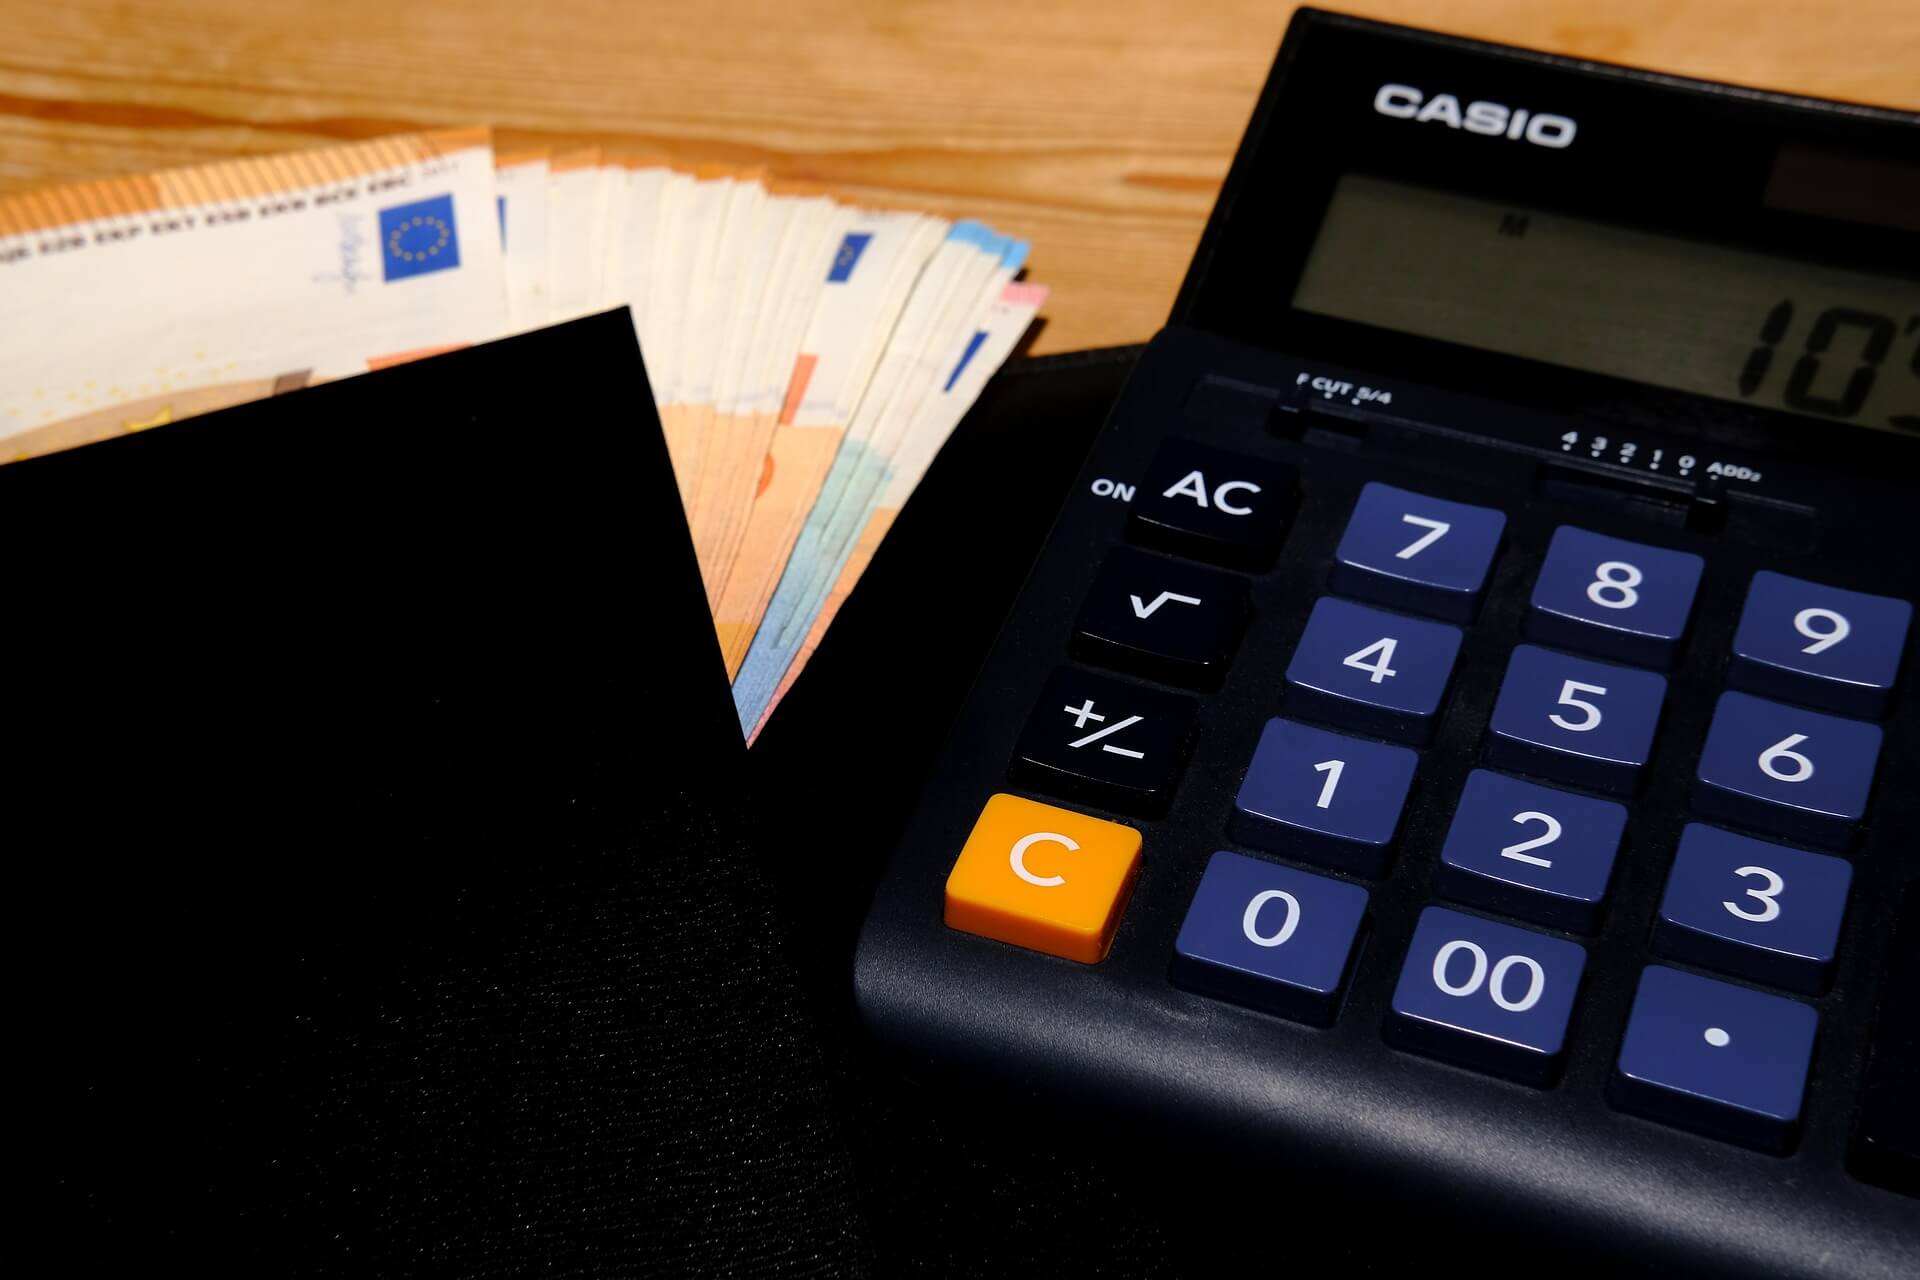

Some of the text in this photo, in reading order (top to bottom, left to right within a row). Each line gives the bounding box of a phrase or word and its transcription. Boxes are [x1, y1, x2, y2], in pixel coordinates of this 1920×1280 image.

[1373, 83, 1578, 149] CASIO
[1498, 213, 1529, 238] M
[1311, 376, 1353, 396] CUT
[1561, 431, 1578, 444] 4
[1591, 436, 1608, 451] 3
[1619, 442, 1637, 457] 2
[1653, 449, 1663, 463] 1
[1678, 455, 1696, 469] 0
[1091, 478, 1136, 502] ON
[1162, 470, 1262, 516] AC
[1396, 514, 1450, 559] 7
[1586, 561, 1642, 609] 8
[1794, 608, 1850, 655] 9
[1342, 637, 1398, 684] 4
[1548, 679, 1607, 732] 5
[1758, 733, 1814, 782] 6
[1313, 759, 1345, 809] 1
[1009, 832, 1080, 887] C
[1500, 811, 1562, 868] 2
[1242, 889, 1301, 947] 0
[1722, 866, 1784, 922] 3
[1432, 940, 1545, 1012] 00
